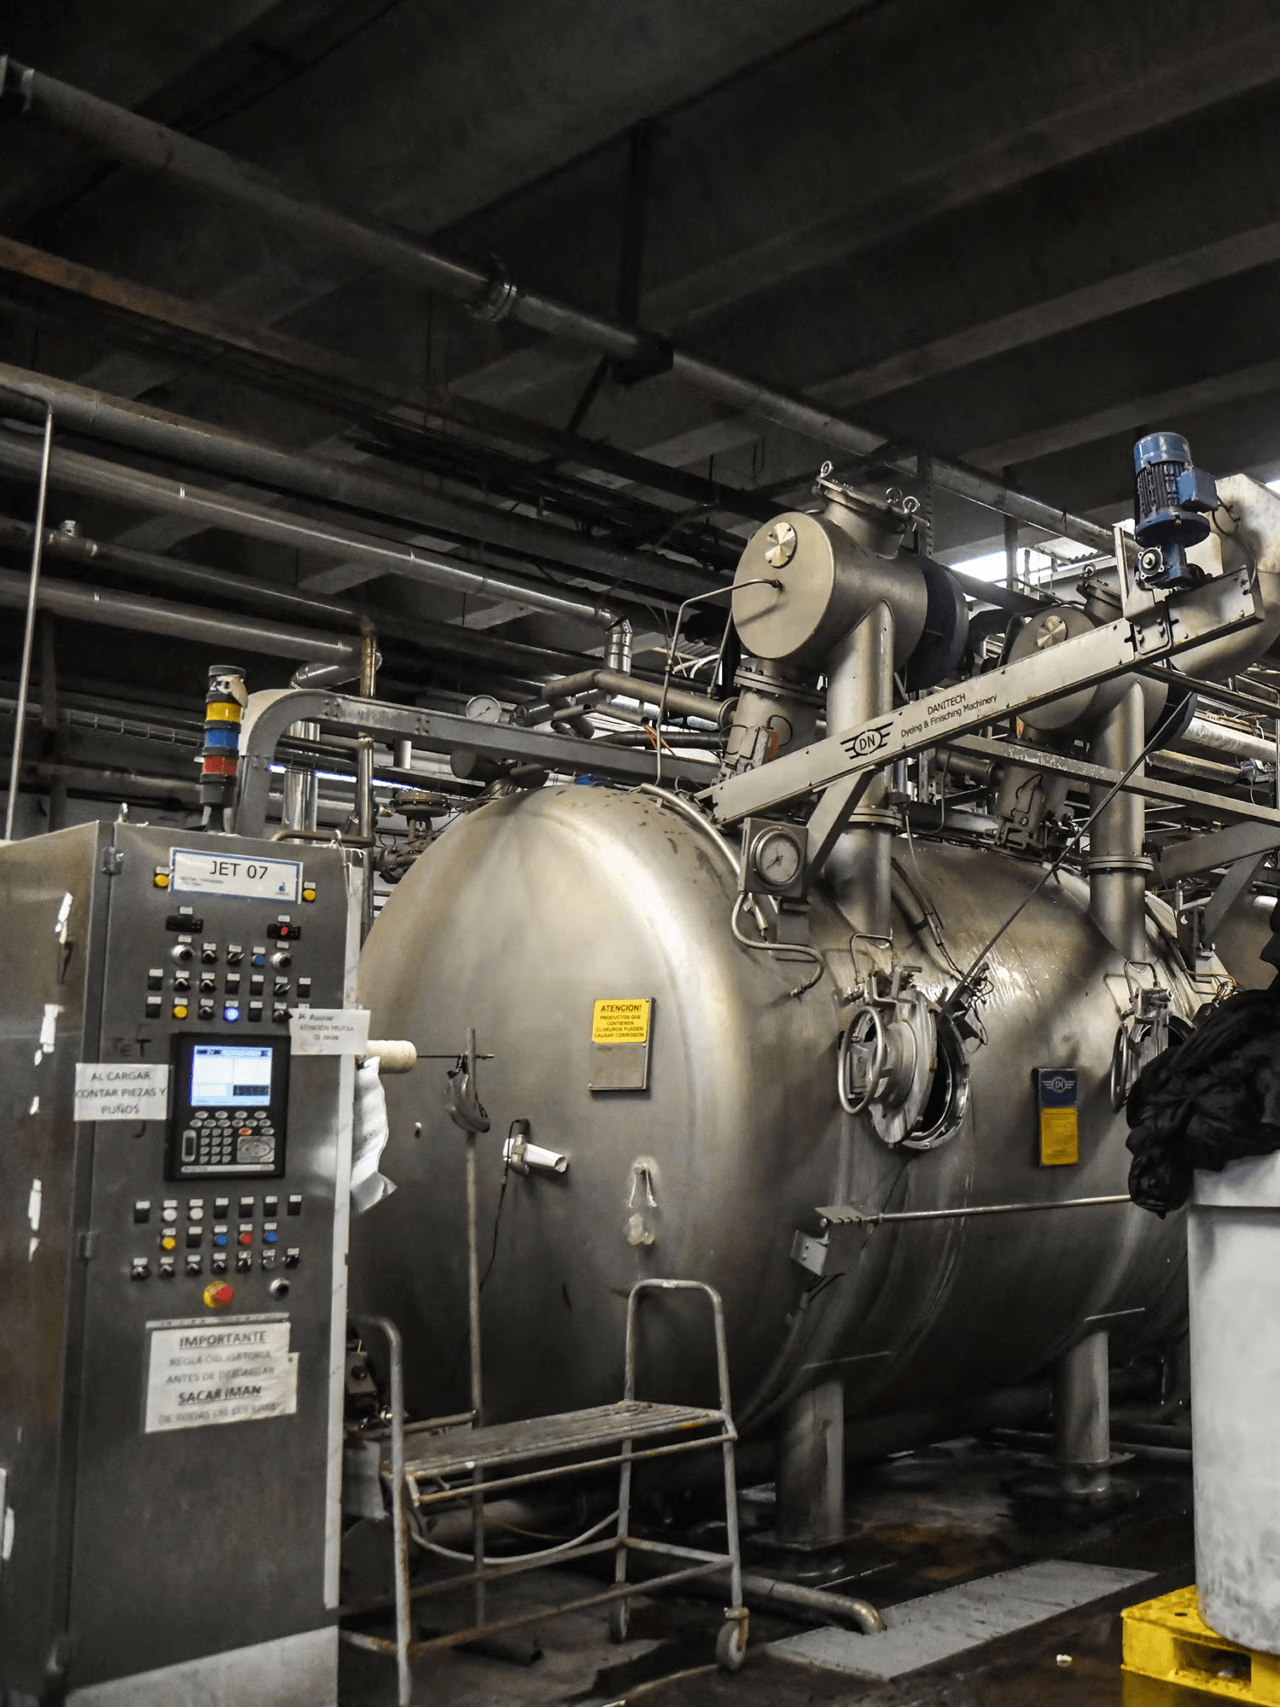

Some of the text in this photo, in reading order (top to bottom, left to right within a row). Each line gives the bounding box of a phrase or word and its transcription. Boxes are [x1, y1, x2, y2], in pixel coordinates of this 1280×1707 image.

[928, 693, 966, 715] DANITECH
[901, 694, 998, 738] Dyeing & Finisching Machinery
[859, 734, 876, 751] DN
[210, 861, 268, 880] JET 07
[91, 1071, 151, 1082] AL CARGAR
[75, 1087, 167, 1099] CONTAR PIEZAS Y
[101, 1103, 140, 1115] PUÑOS
[180, 1330, 267, 1348] IMPORTANTE
[178, 1388, 222, 1403] SACAR
